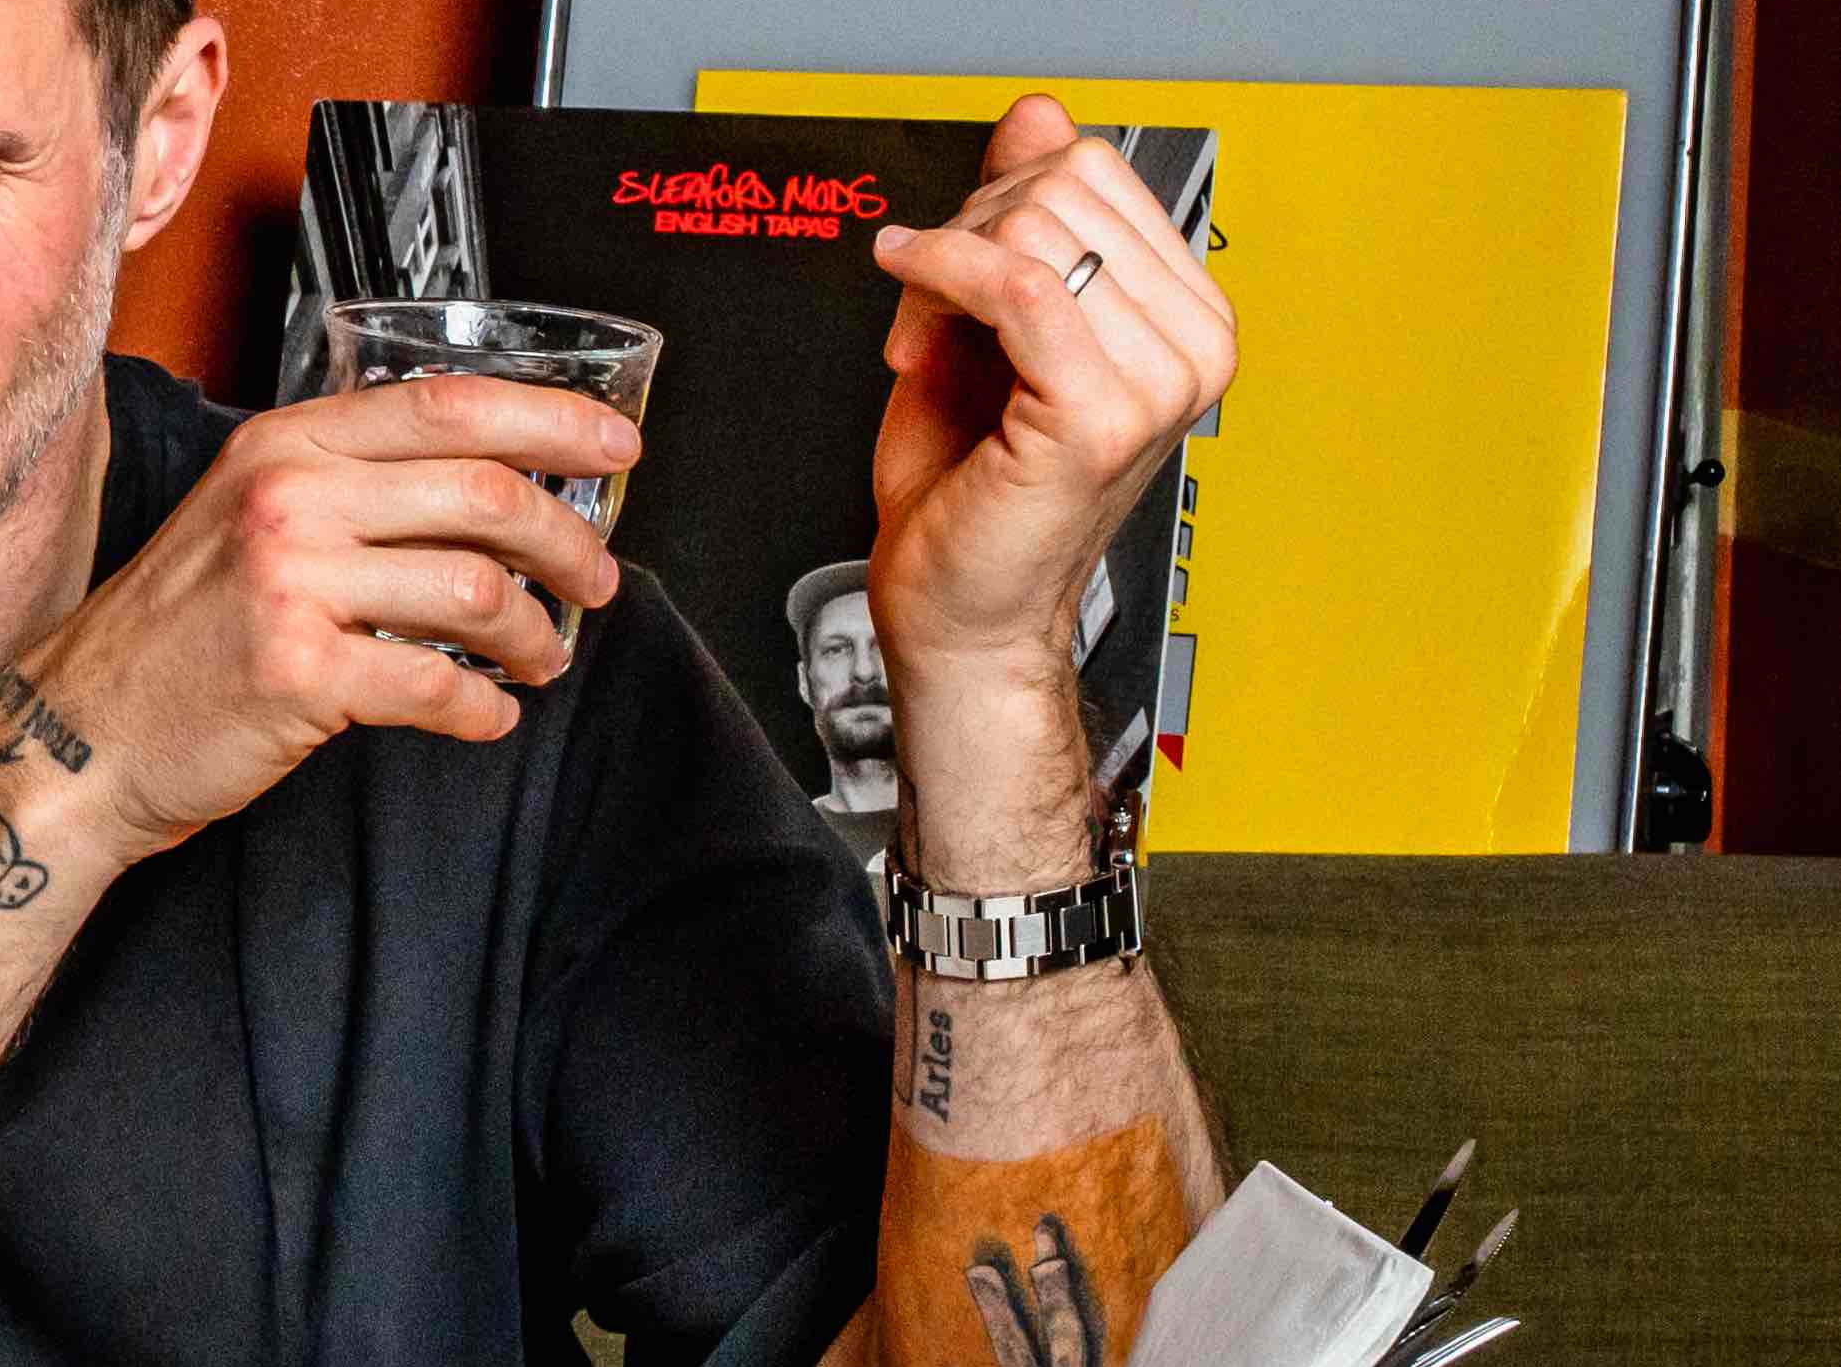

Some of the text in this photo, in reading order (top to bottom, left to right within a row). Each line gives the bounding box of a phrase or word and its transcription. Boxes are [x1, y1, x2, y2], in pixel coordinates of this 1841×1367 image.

[612, 163, 888, 219] SLEAFORD MODS
[653, 211, 841, 241] ENGLISH TAPAS
[920, 1008, 954, 1124] Arles
